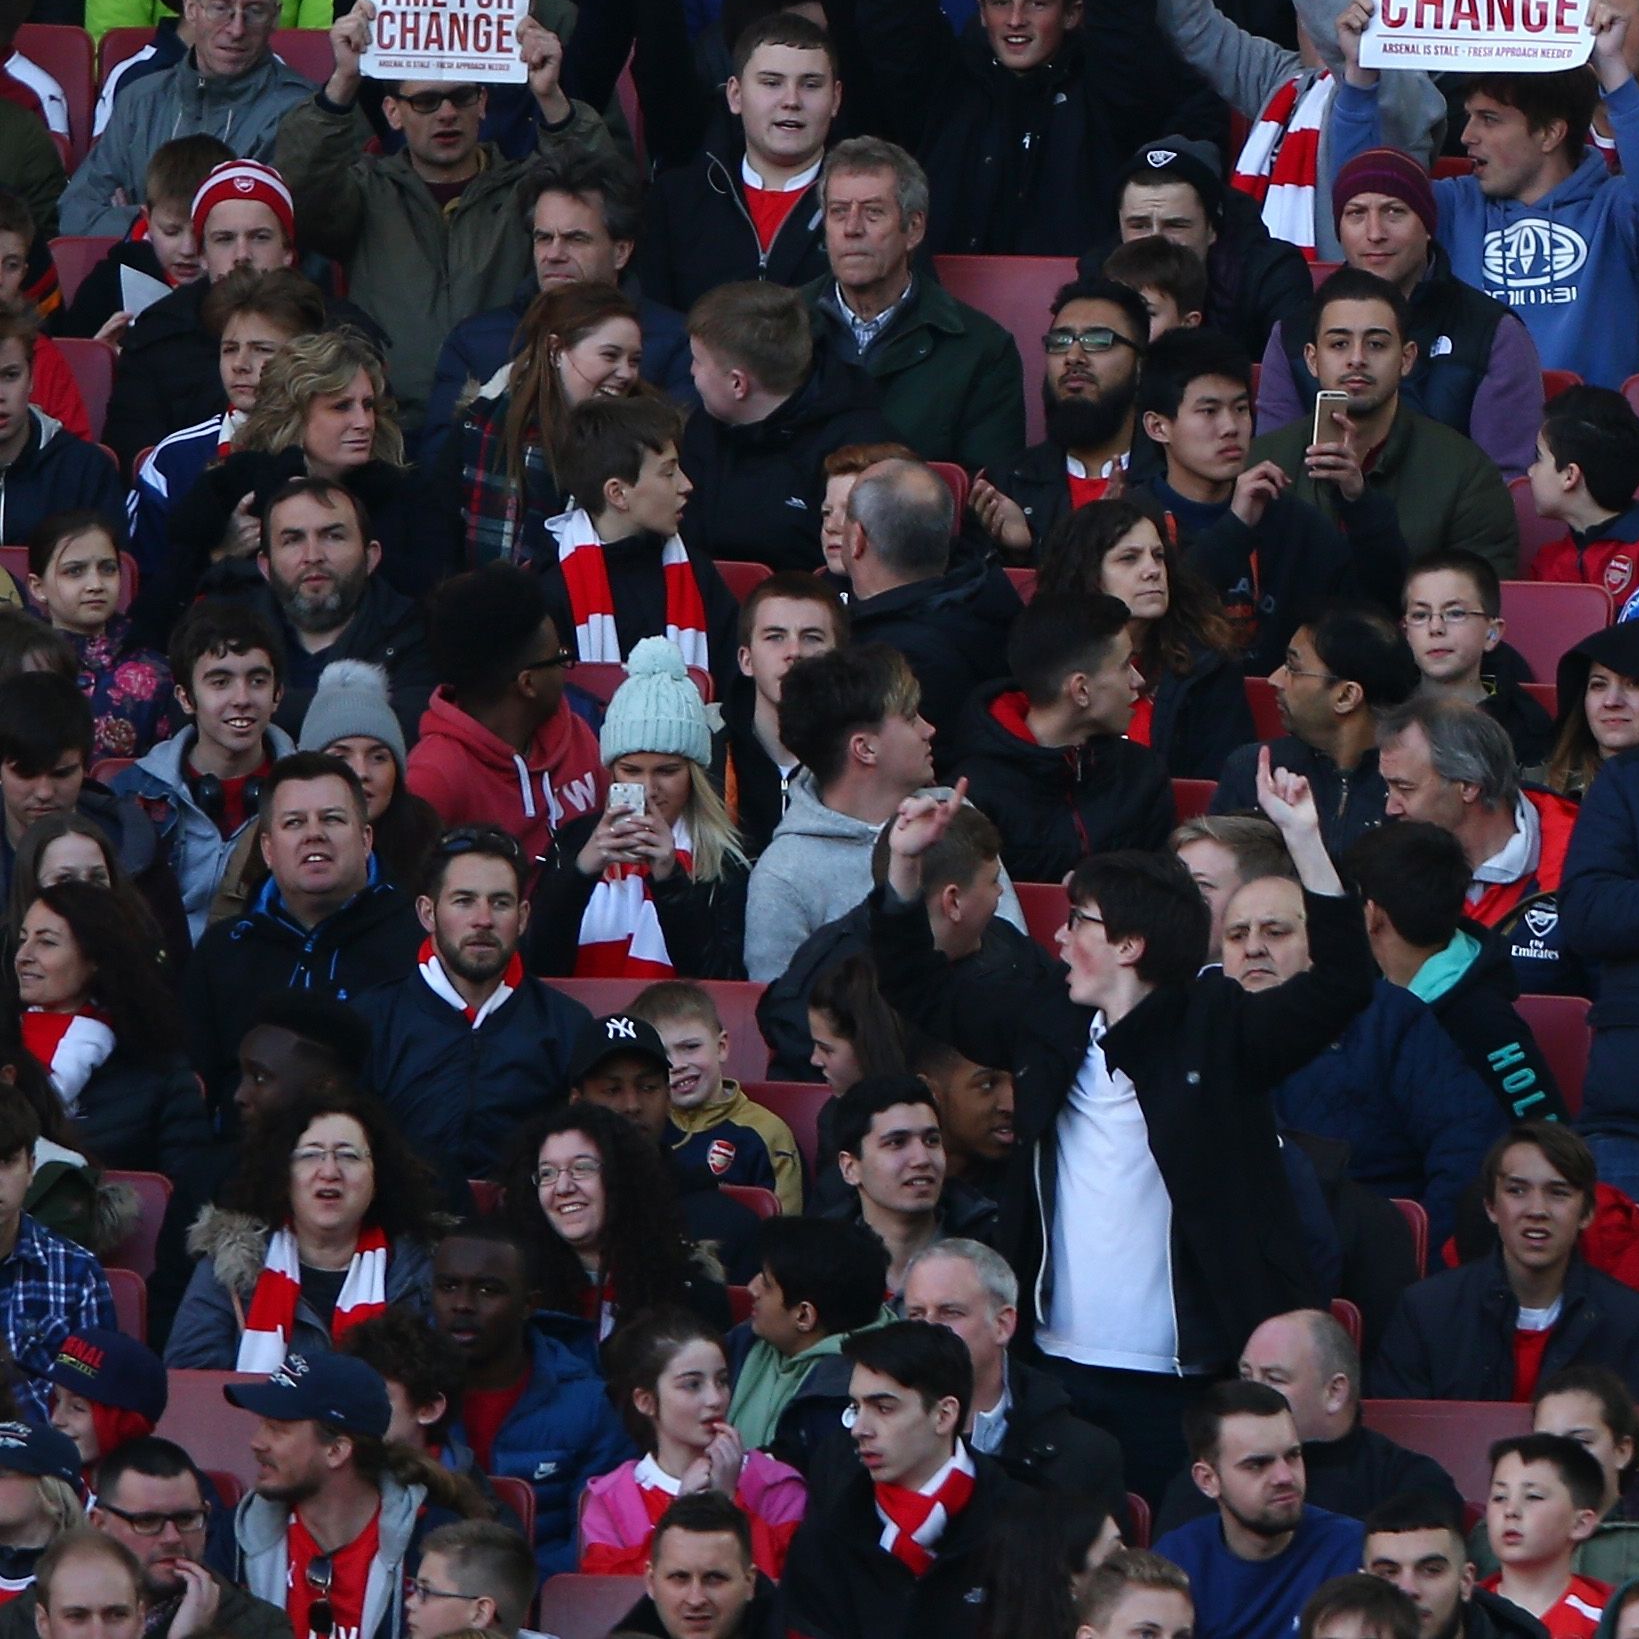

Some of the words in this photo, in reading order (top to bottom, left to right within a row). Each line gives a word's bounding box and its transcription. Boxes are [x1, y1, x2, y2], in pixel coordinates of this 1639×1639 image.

[379, 13, 512, 53] CHANGE
[1510, 944, 1560, 960] Emirates
[1485, 1040, 1558, 1122] HOL
